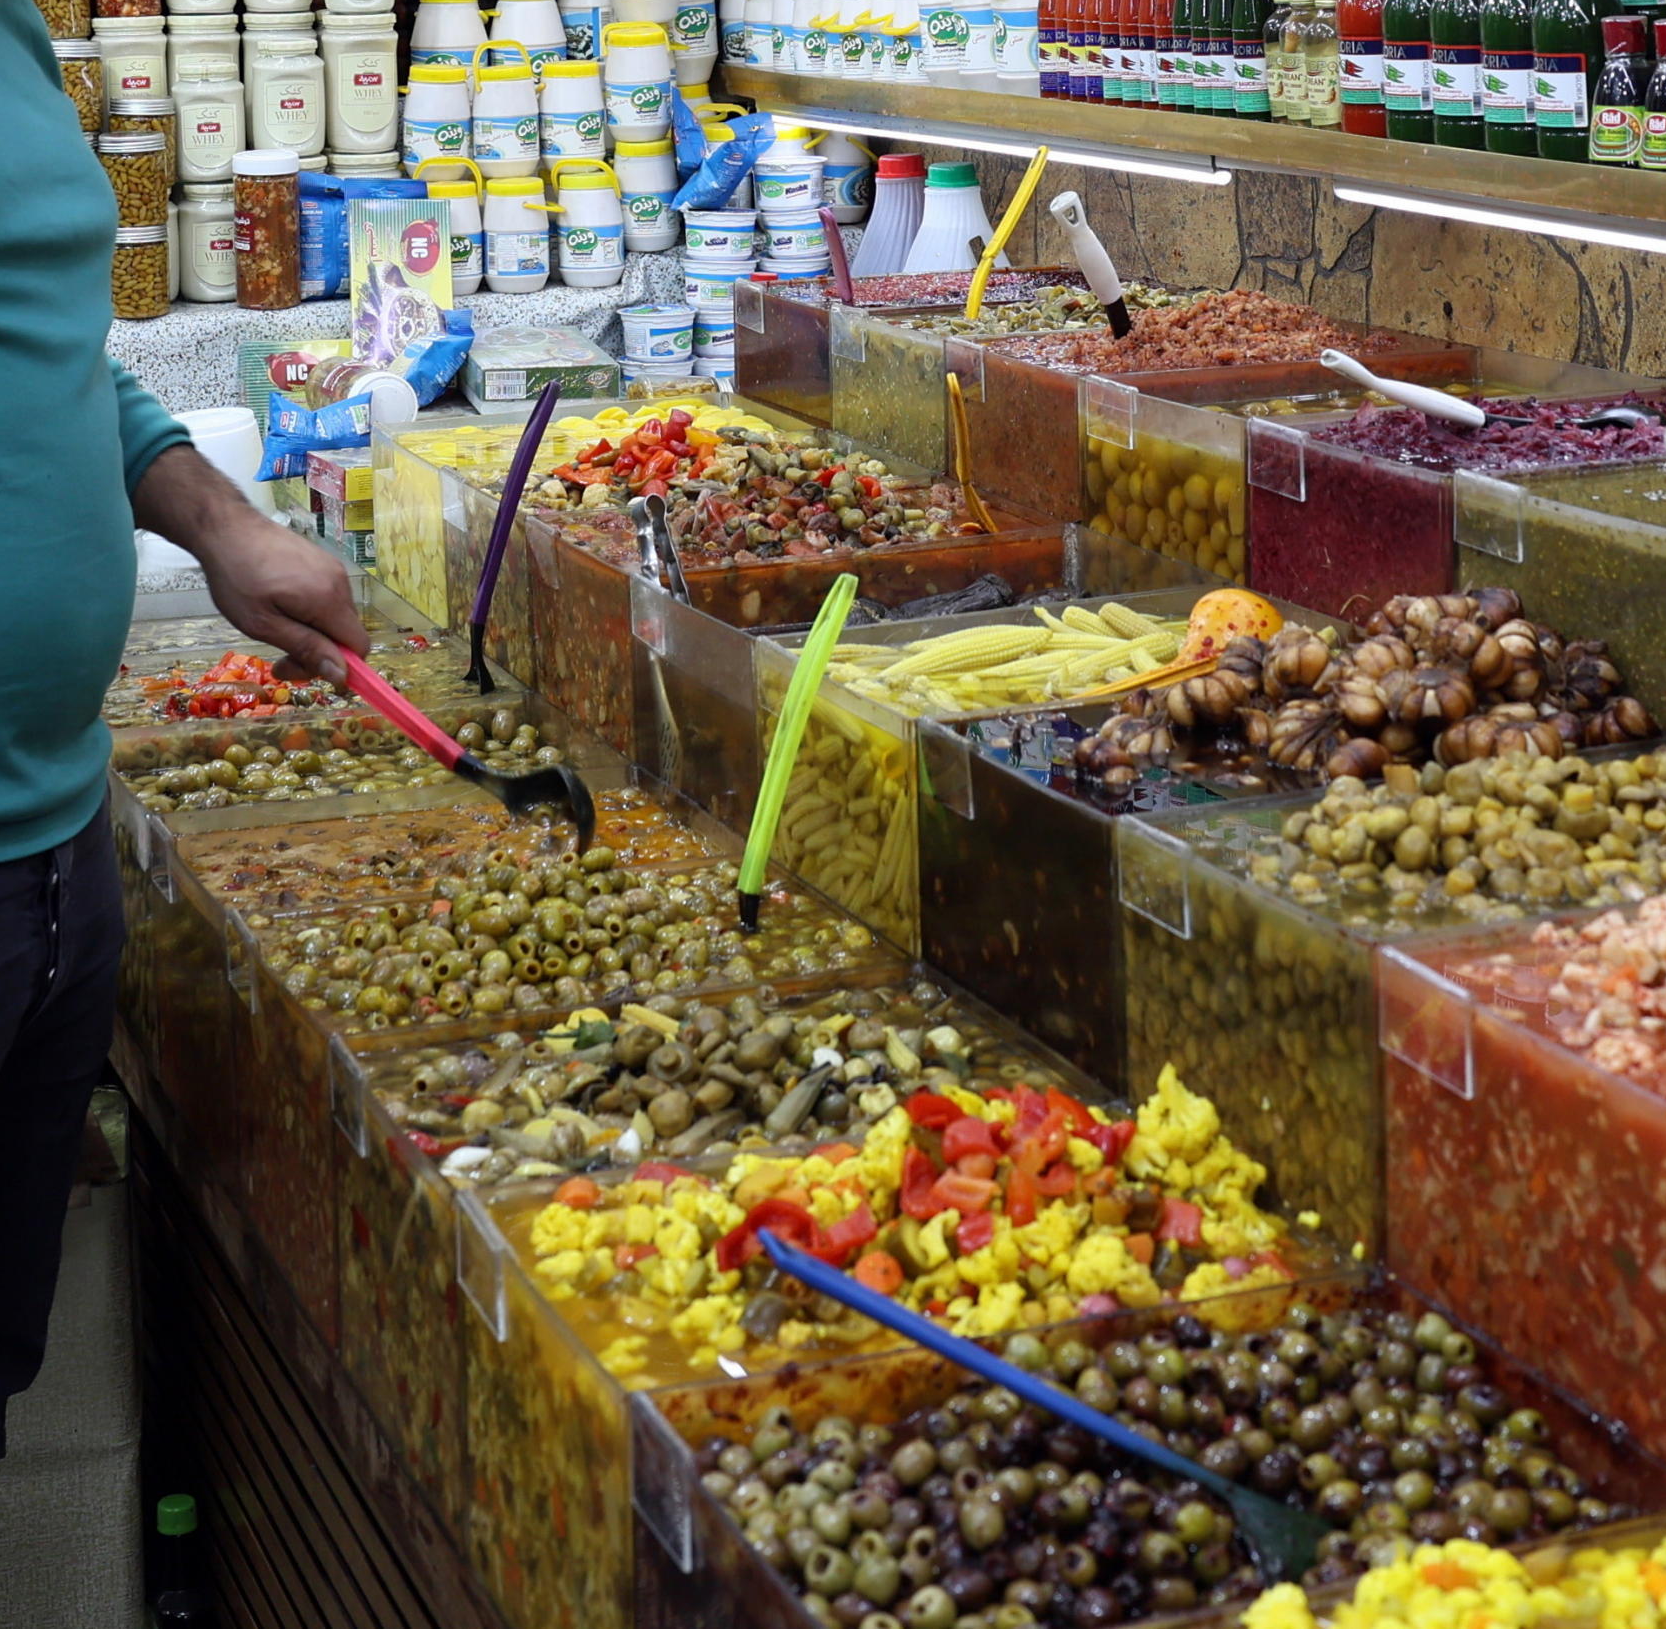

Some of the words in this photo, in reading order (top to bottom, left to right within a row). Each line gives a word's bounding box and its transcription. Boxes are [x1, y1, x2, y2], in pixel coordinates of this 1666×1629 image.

[353, 87, 383, 100] WHEY
[632, 87, 661, 106] وینه
[275, 109, 309, 123] WHEY
[191, 132, 227, 146] WHEY
[437, 124, 463, 142] وینه
[785, 182, 809, 196] Kashk
[632, 196, 662, 214] وینه
[410, 236, 428, 260] NC
[567, 232, 597, 248] وینه
[286, 363, 310, 381] NC
